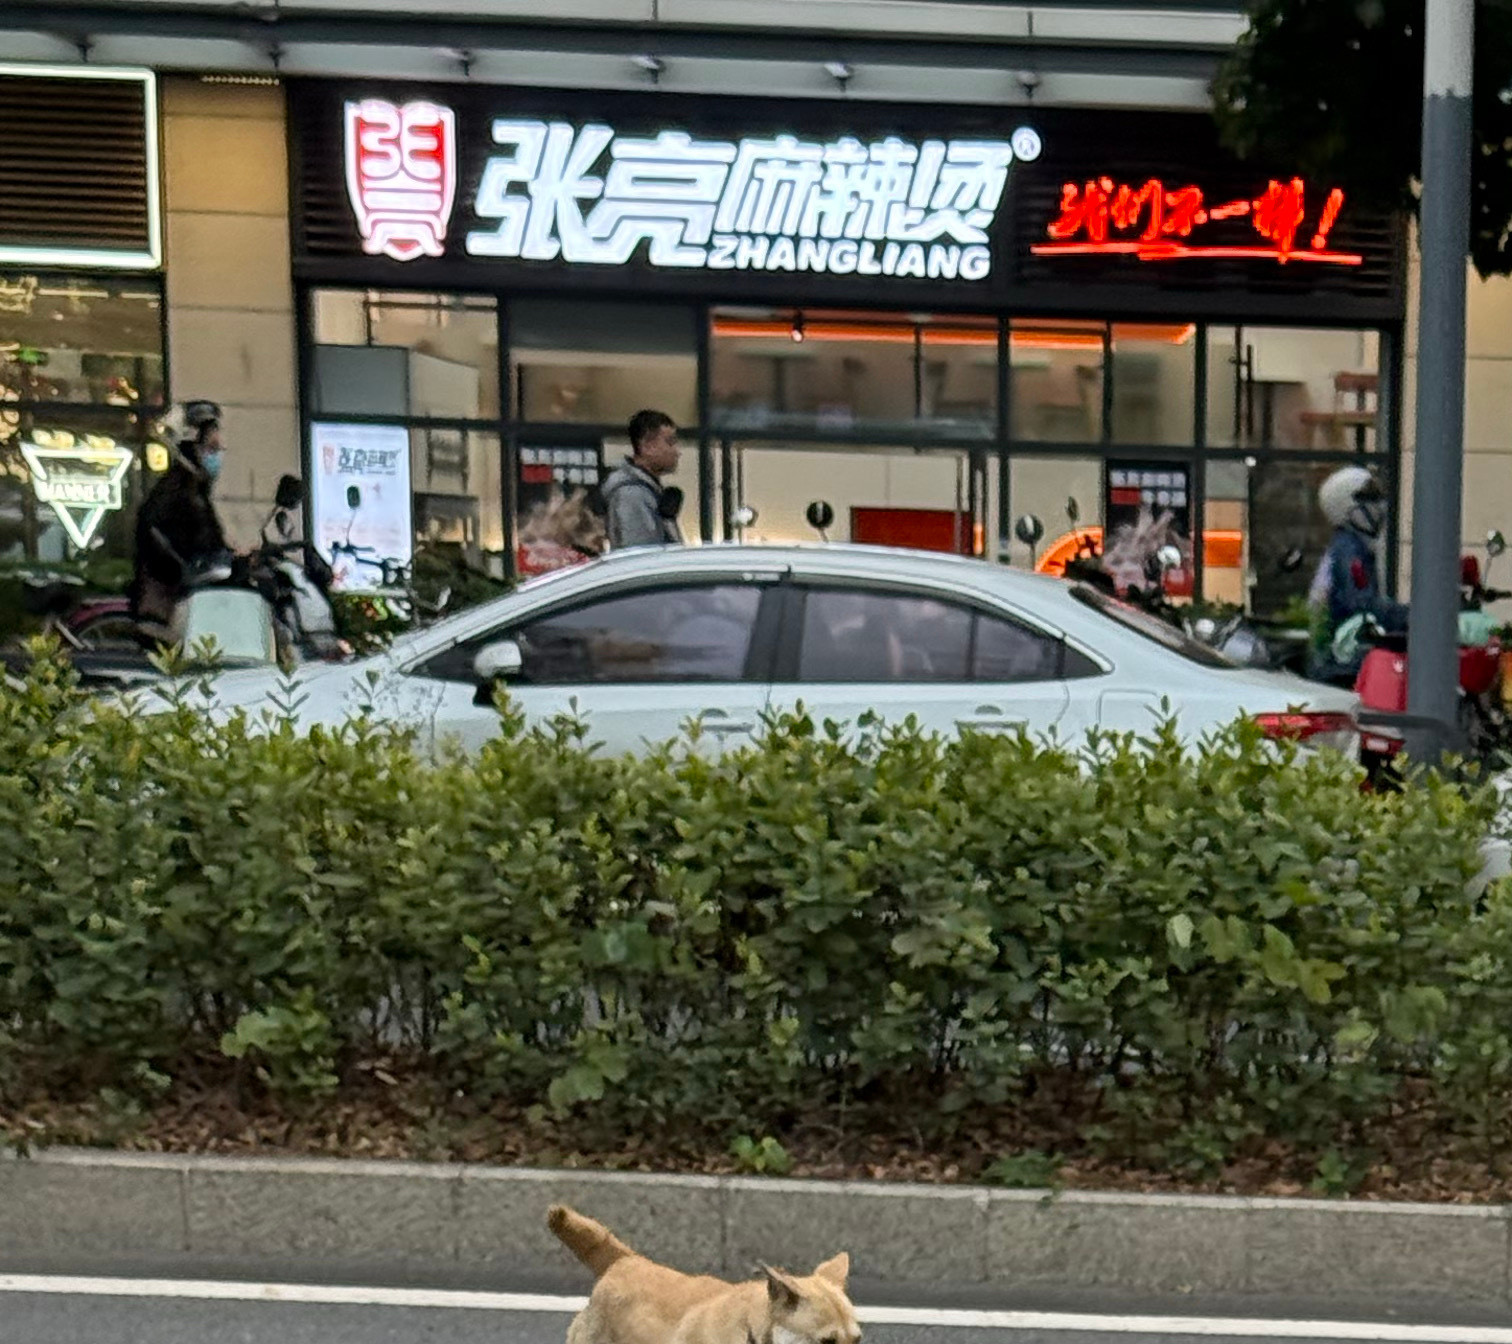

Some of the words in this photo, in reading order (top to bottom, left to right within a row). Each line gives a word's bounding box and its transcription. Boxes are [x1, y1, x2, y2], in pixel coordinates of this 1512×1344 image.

[466, 118, 1013, 268] 张亮麻辣烫
[706, 234, 991, 281] ZHANGLIANG
